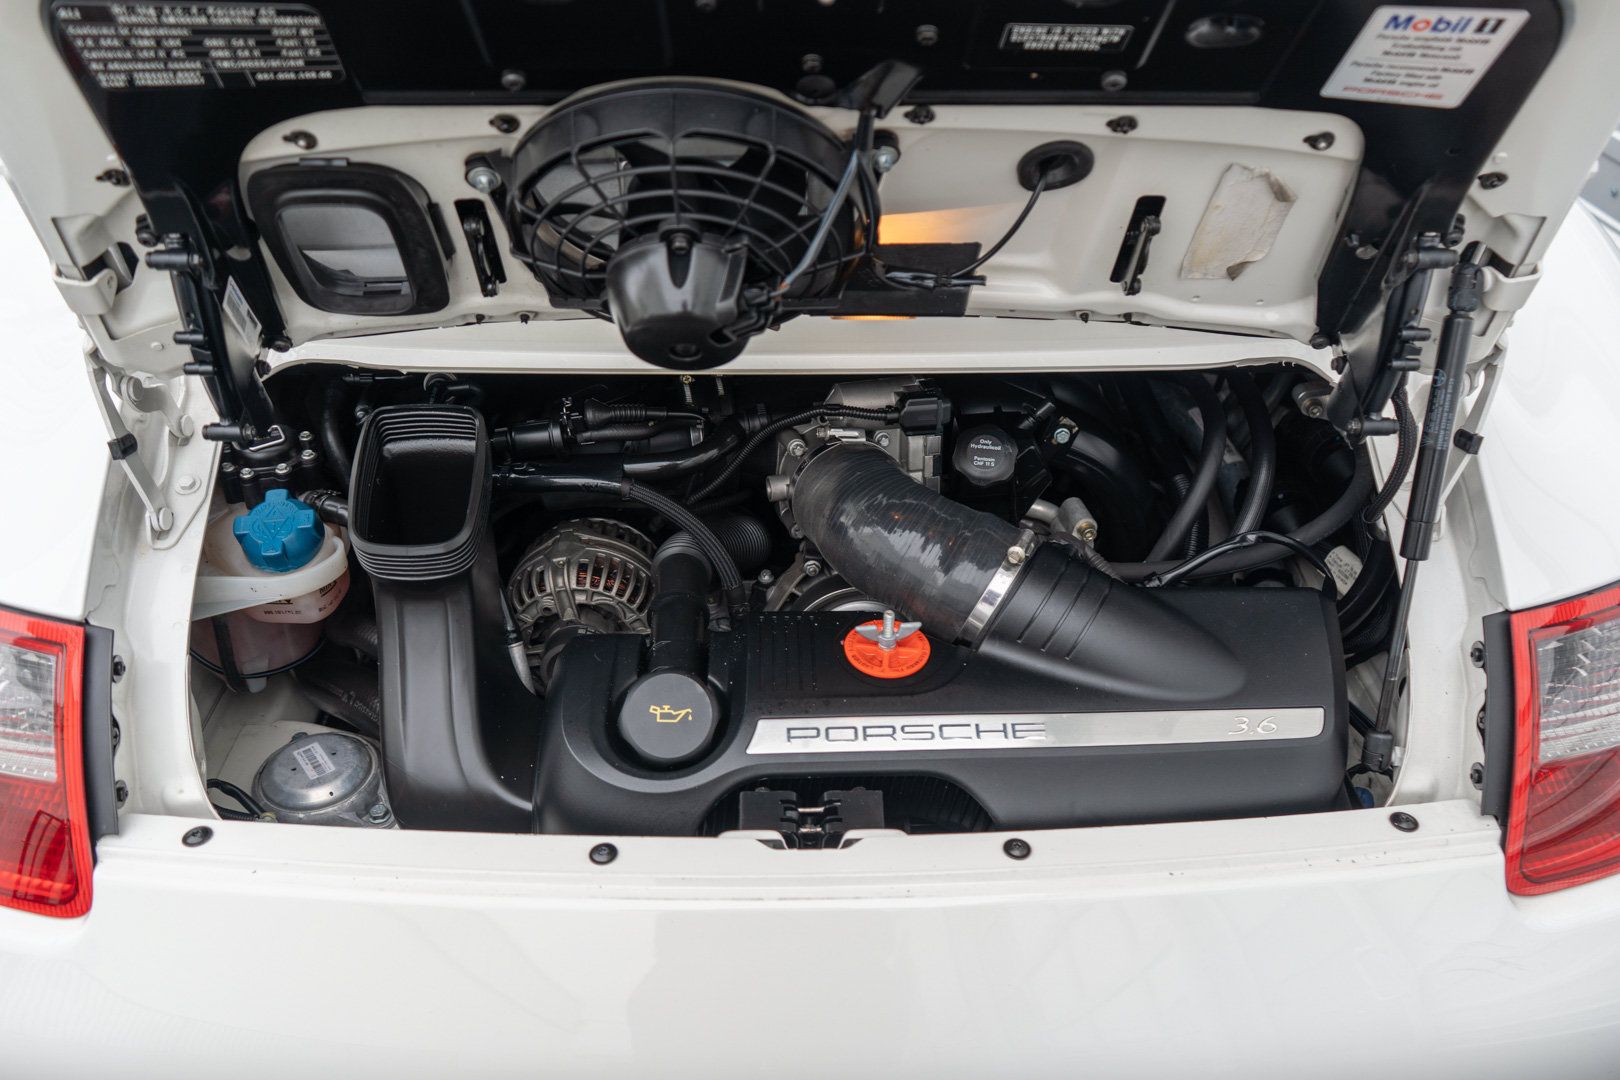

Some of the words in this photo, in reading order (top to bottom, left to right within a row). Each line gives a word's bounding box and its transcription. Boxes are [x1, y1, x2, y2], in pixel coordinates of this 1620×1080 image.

[1383, 15, 1473, 34] Mobil
[785, 722, 1046, 743] PORSCHE
[1227, 715, 1278, 737] 3.6
